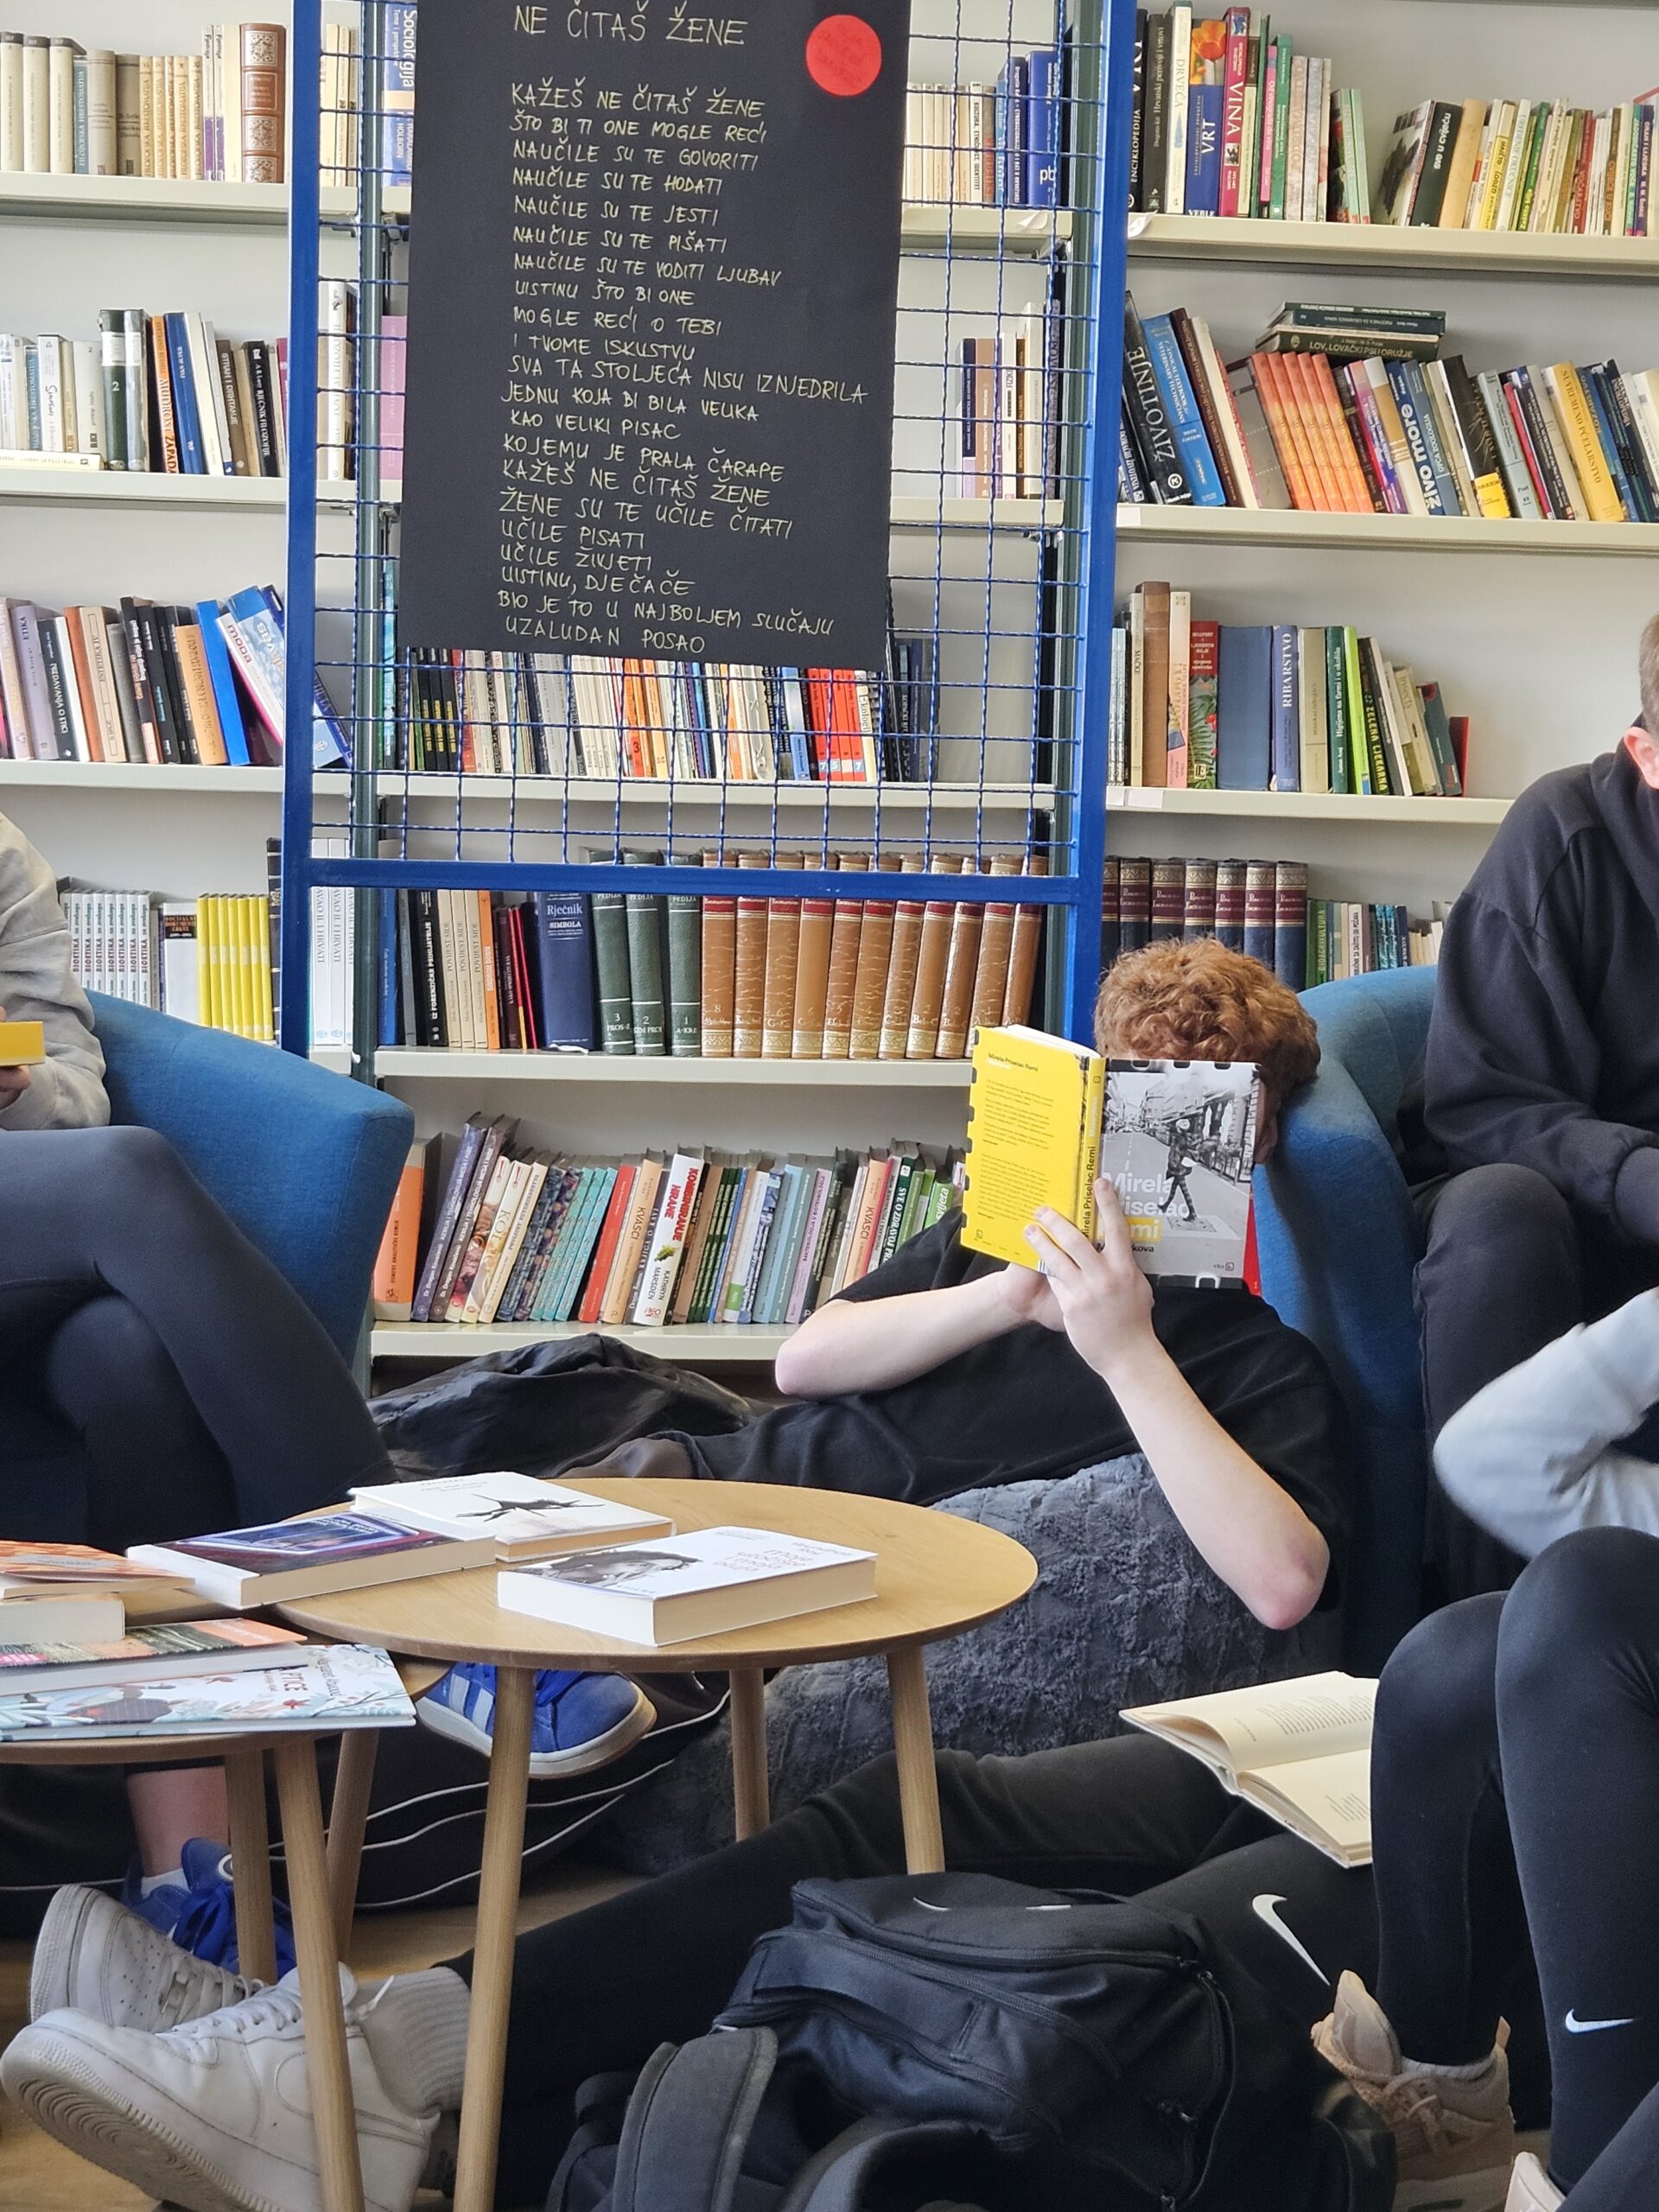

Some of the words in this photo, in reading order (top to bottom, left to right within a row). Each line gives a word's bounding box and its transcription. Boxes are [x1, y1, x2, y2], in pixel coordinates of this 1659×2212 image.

[514, 5, 547, 35] NE
[568, 0, 649, 41] ČITAŠ
[665, 0, 748, 46] ŽENE
[512, 76, 586, 108] KAŽEŠ
[596, 91, 623, 109] NE
[632, 83, 697, 114] ČITAŠ
[705, 87, 765, 118] ŽENE
[1227, 82, 1244, 136] VINA
[509, 109, 542, 130] ŠTO
[551, 118, 568, 134] BI
[576, 118, 592, 135] TI
[604, 120, 639, 136] ONE
[652, 121, 712, 141] MOGLE
[725, 121, 766, 143] REĆI
[1201, 118, 1216, 154] VRT
[513, 136, 600, 162] NAUČILE
[613, 146, 634, 162] SU
[645, 149, 665, 164] TE
[679, 149, 758, 171] GOVORITI
[1130, 110, 1141, 182] ENCIKLOPEDIJA
[513, 165, 589, 188] NAUČILE
[601, 172, 624, 189] SU
[630, 175, 653, 191] TE
[664, 175, 722, 195] HODATI
[515, 194, 588, 219] NAUČILE
[601, 201, 619, 218] SU
[629, 205, 653, 221] TE
[664, 205, 718, 226] JESTI
[513, 224, 591, 246] NAUČILE
[601, 230, 623, 248] SU
[630, 233, 653, 249] TE
[514, 251, 586, 271] NAUČILE
[596, 257, 617, 273] SU
[623, 260, 646, 275] TE
[657, 262, 704, 280] VODITI
[717, 265, 781, 286] LJUBAV
[516, 280, 578, 299] UISTINU
[592, 278, 624, 300] ŠTO
[635, 286, 651, 302] BI
[659, 289, 695, 305] ONE
[513, 306, 580, 327] MOGLE
[594, 306, 637, 333] REĆI
[651, 318, 664, 332] O
[676, 318, 721, 336] TEBI
[514, 334, 517, 346] I
[529, 335, 591, 355] TVOME
[605, 340, 695, 360] ISKUSTVU
[111, 381, 120, 392] 2
[508, 355, 542, 376] SVA
[555, 359, 582, 378] TA
[591, 360, 692, 386] STOLJEĆA
[703, 367, 744, 391] NISU
[758, 374, 868, 404] IZNJEDRILA
[500, 381, 558, 404] JEDNU
[572, 387, 613, 405] KOJA
[622, 391, 638, 409] BI
[648, 395, 687, 415] BILA
[1128, 346, 1176, 462] ŽIVOTINJE
[511, 409, 543, 427] KAO
[556, 414, 610, 435] VELIKI
[622, 419, 681, 439] PISAC
[1401, 405, 1428, 465] more
[503, 433, 588, 459] KOJEMU
[604, 443, 625, 461] JE
[640, 448, 696, 470] PRALA
[708, 447, 785, 482] ČARAPE
[503, 458, 575, 485] KAŽEŠ
[590, 467, 620, 490] NE
[633, 466, 698, 499] ČITAŠ
[710, 476, 770, 506] ŽENE
[499, 486, 562, 517] ŽENE
[575, 498, 603, 519] SU
[614, 502, 643, 522] TE
[656, 499, 715, 527] UČILE
[730, 506, 792, 539] ČITATI
[502, 516, 567, 543] UČILE
[580, 526, 644, 550] PISATI
[501, 542, 560, 566] UČILE
[575, 546, 652, 571] ŽIVJETI
[585, 569, 696, 595] DJEČAČE
[498, 590, 528, 608] BIO
[536, 595, 561, 613] JE
[569, 600, 592, 617] TO
[607, 601, 618, 619] U
[634, 602, 741, 628] NAJBOLJEM
[752, 608, 834, 635] SLUČAJU
[506, 615, 619, 645] UZALUDAN
[641, 629, 704, 653] POSAO
[1281, 632, 1293, 709] RIBARSTVO
[546, 904, 583, 915] Rječnik
[549, 920, 582, 929] SIMBOLA
[614, 1014, 620, 1022] 3
[643, 1016, 650, 1025] 2
[684, 1016, 689, 1026] 1
[1087, 1145, 1096, 1173] Remi
[664, 1184, 682, 1219] HRANE
[672, 1167, 699, 1243] KOMBINIRANJE
[1084, 1174, 1095, 1216] Priselac
[630, 1207, 646, 1240] KVASCI
[863, 1205, 874, 1241] KVASCI
[648, 1267, 662, 1300] MARSDEN
